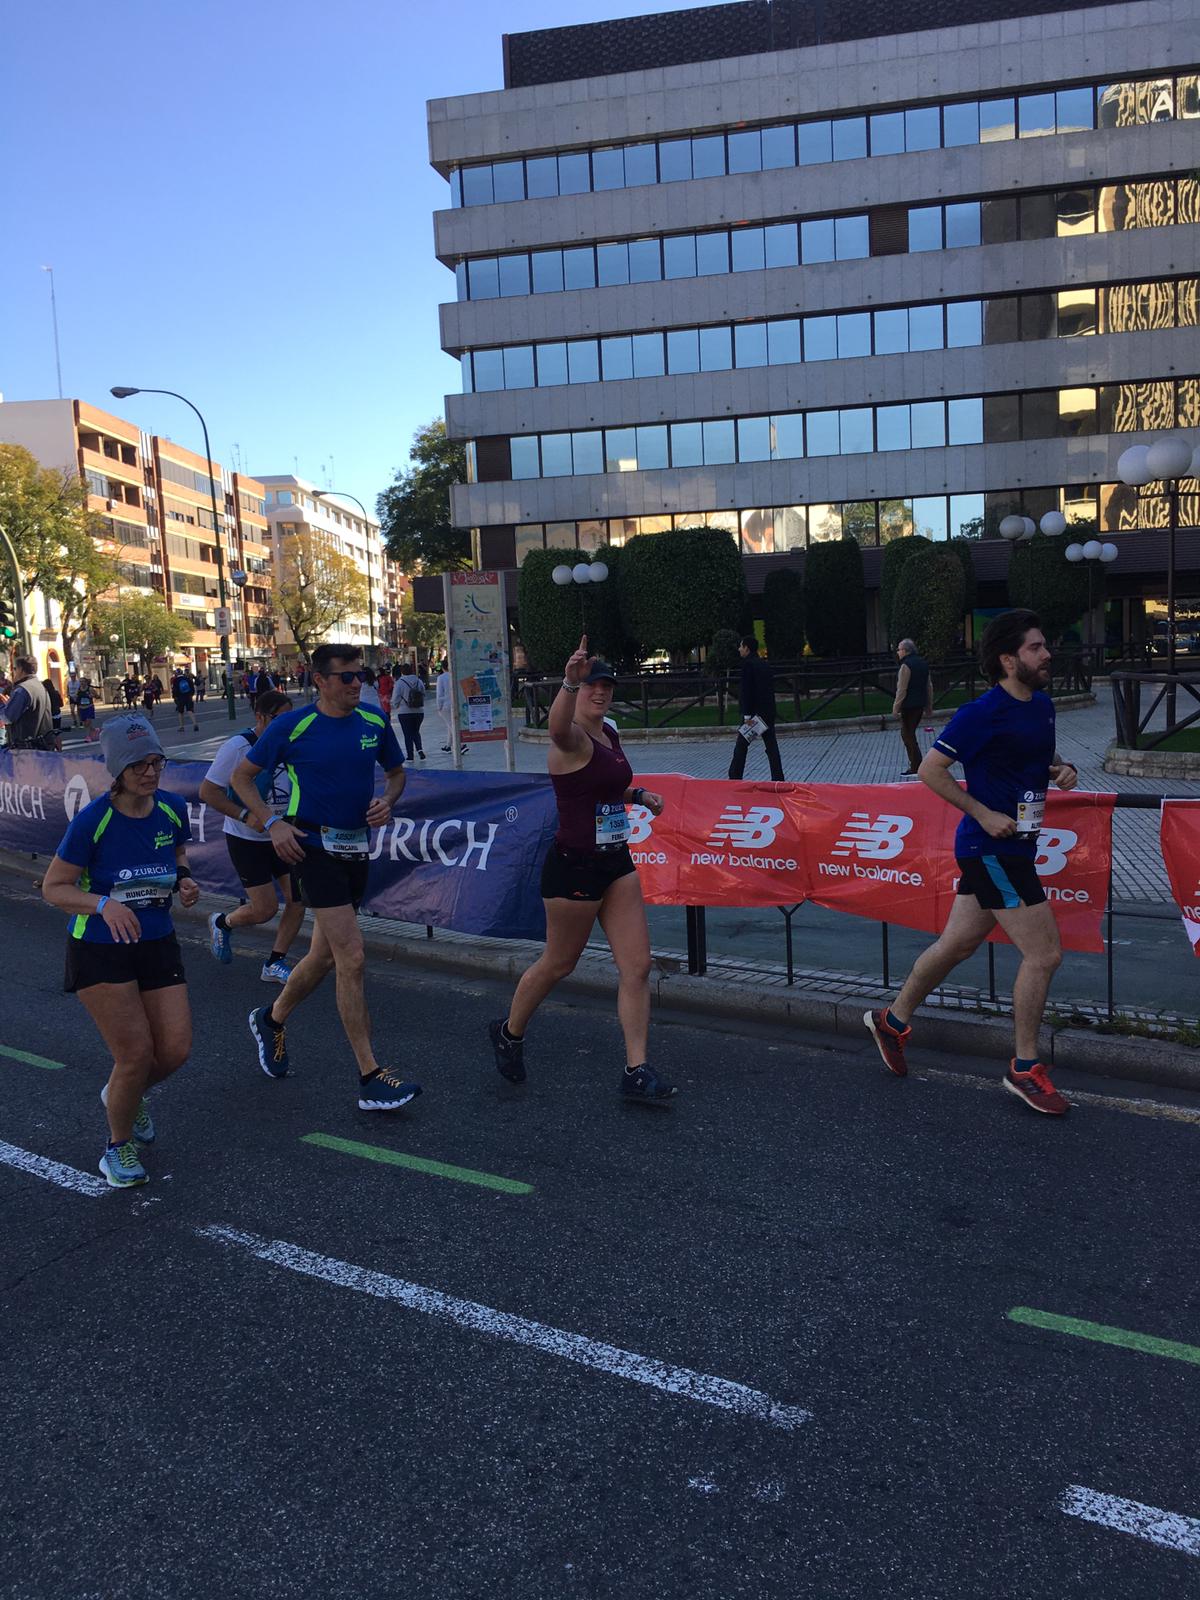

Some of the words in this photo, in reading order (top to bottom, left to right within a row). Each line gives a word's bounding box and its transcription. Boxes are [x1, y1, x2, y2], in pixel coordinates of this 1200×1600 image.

[691, 852, 725, 865] new
[134, 866, 168, 876] ZURICH
[818, 862, 850, 876] new
